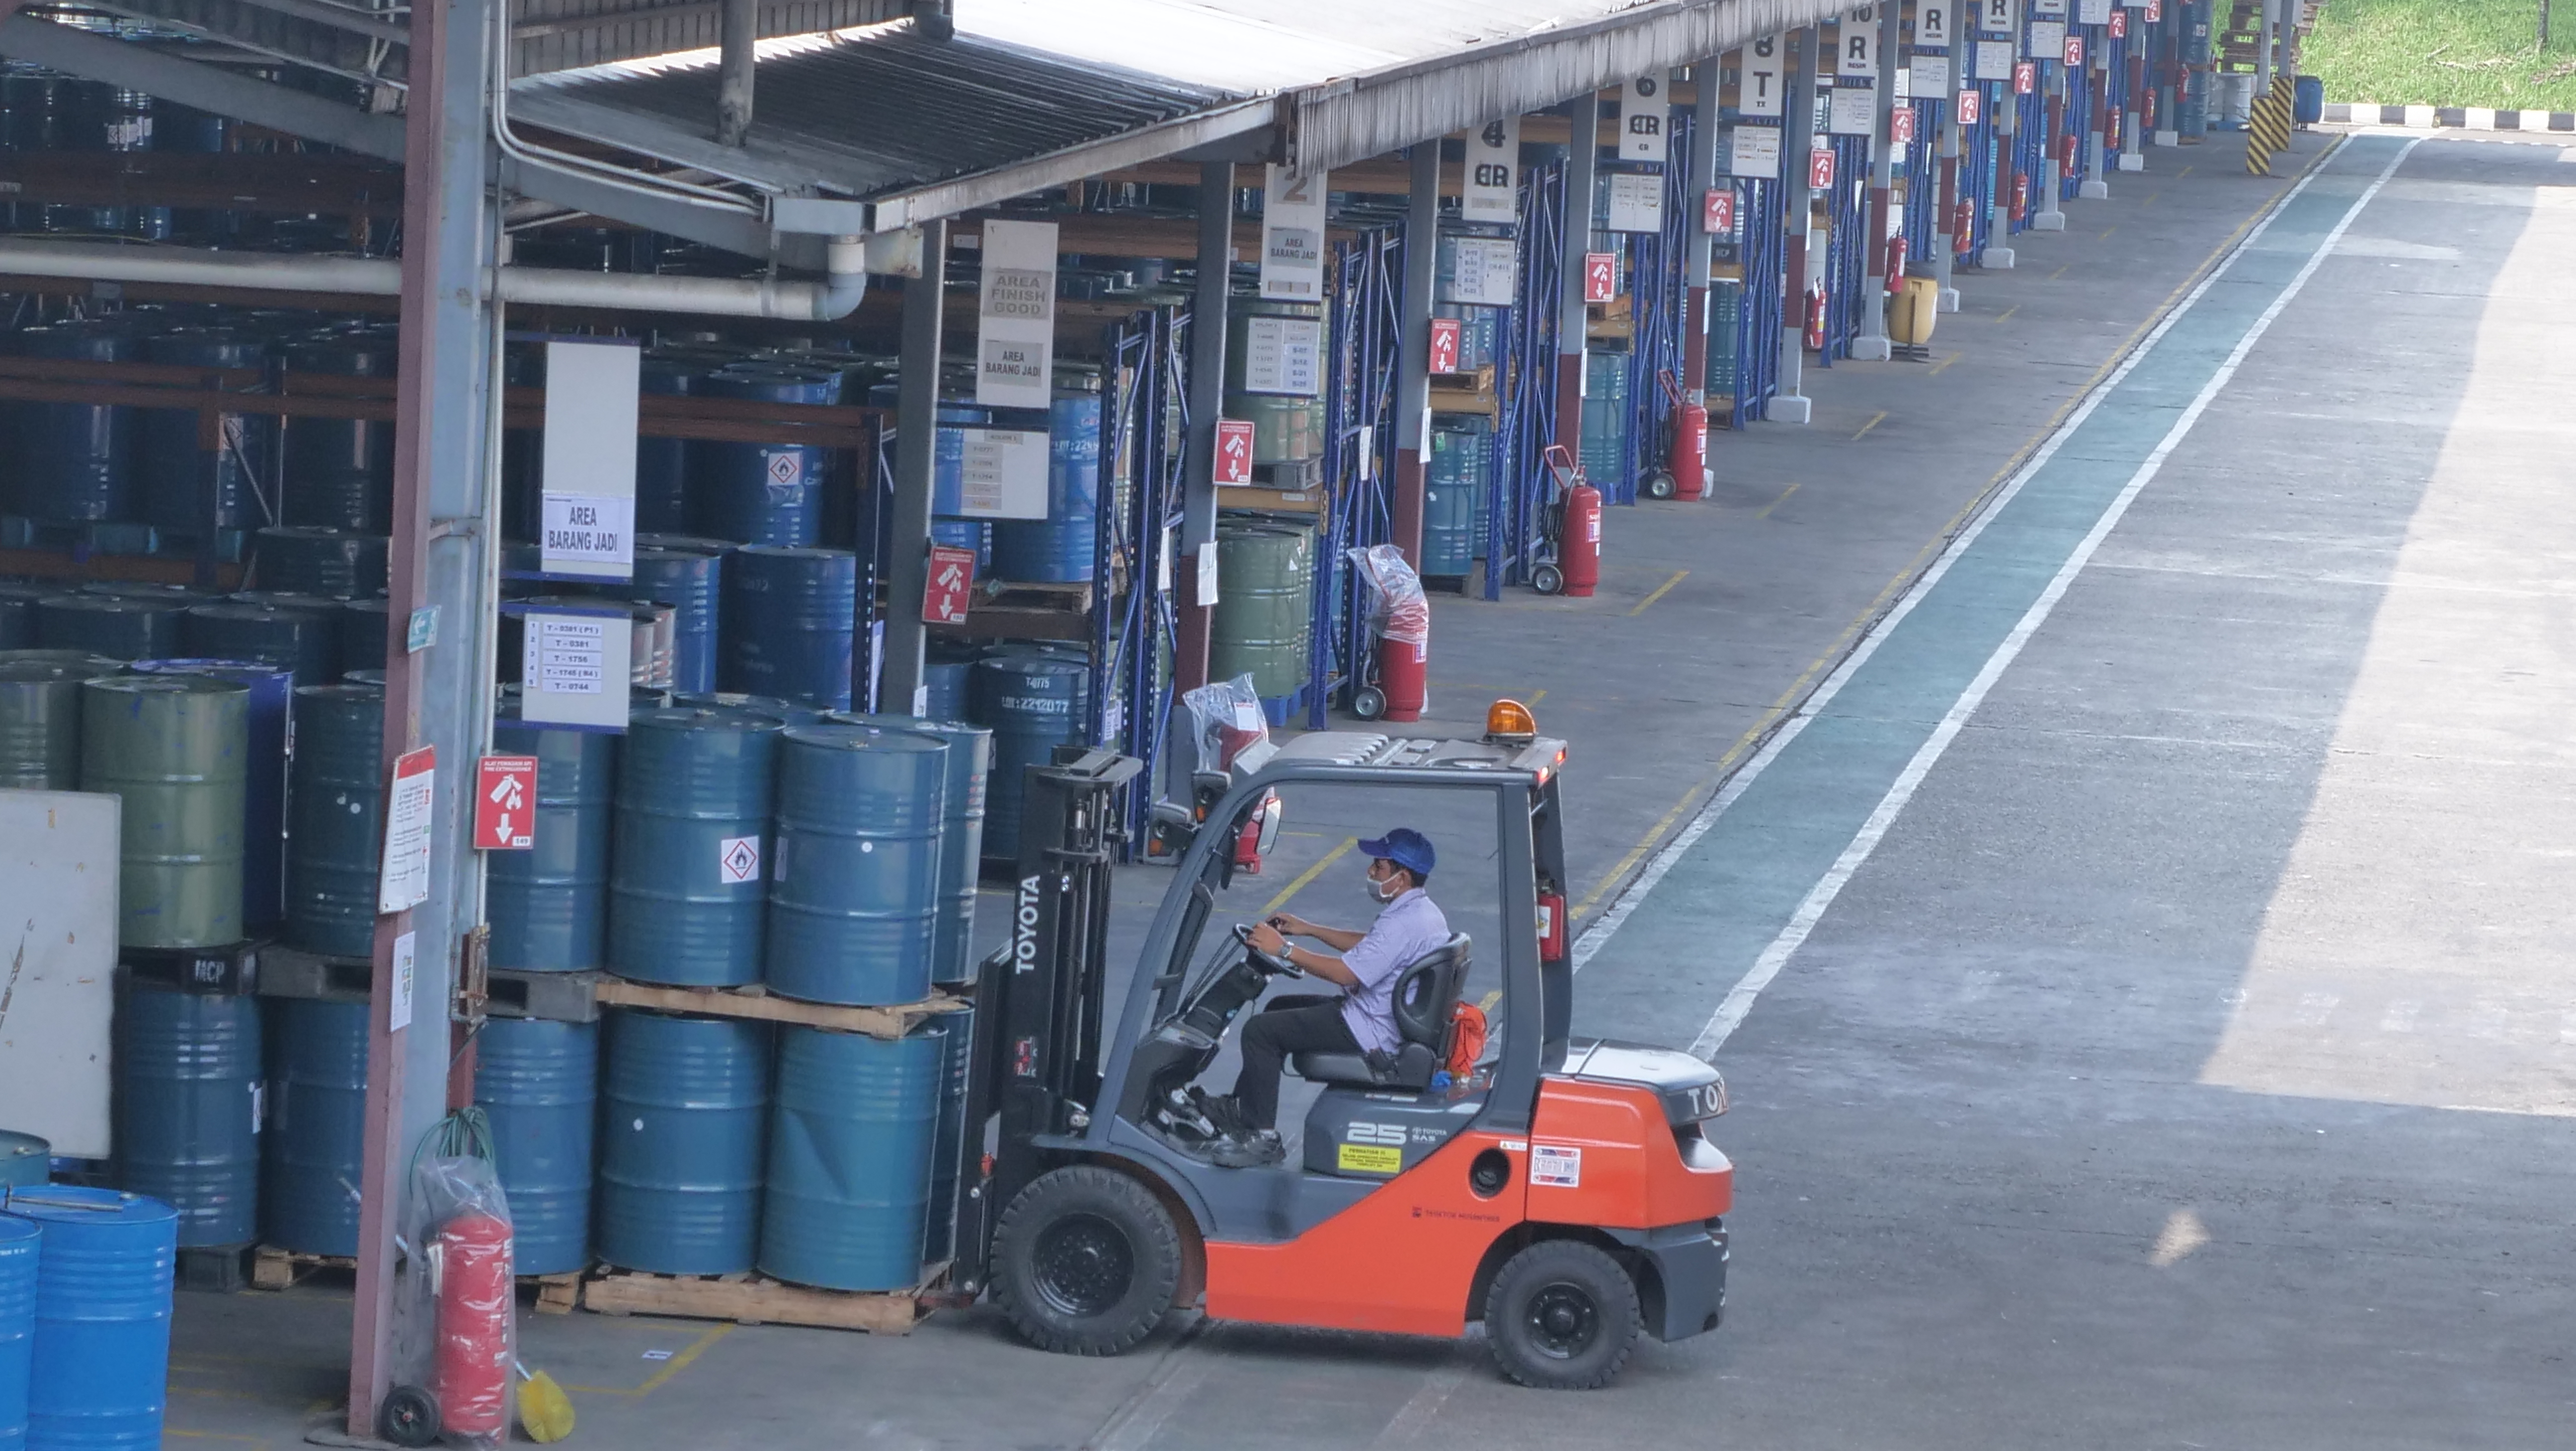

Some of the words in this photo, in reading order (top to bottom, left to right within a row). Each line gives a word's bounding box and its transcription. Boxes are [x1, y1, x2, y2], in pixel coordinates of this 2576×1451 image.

[1925, 9, 1941, 30] R
[1849, 36, 1866, 59] R
[1753, 71, 1772, 97] T
[1285, 238, 1303, 247] AREA
[1271, 248, 1299, 258] BARANG
[1301, 251, 1317, 260] JADI
[997, 276, 1040, 288] AREA
[992, 289, 1046, 302] FINISH
[995, 302, 1040, 314] GOOD
[1002, 351, 1025, 362] AREA
[986, 362, 1020, 375] BARANG
[1022, 365, 1041, 377] JADI
[569, 506, 597, 526] AREA
[549, 530, 591, 551] BARANG
[594, 533, 618, 552] JADI
[1016, 875, 1040, 974] TOYOTA
[1347, 1122, 1407, 1145] 25
[1423, 1127, 1448, 1135] TOYOTA
